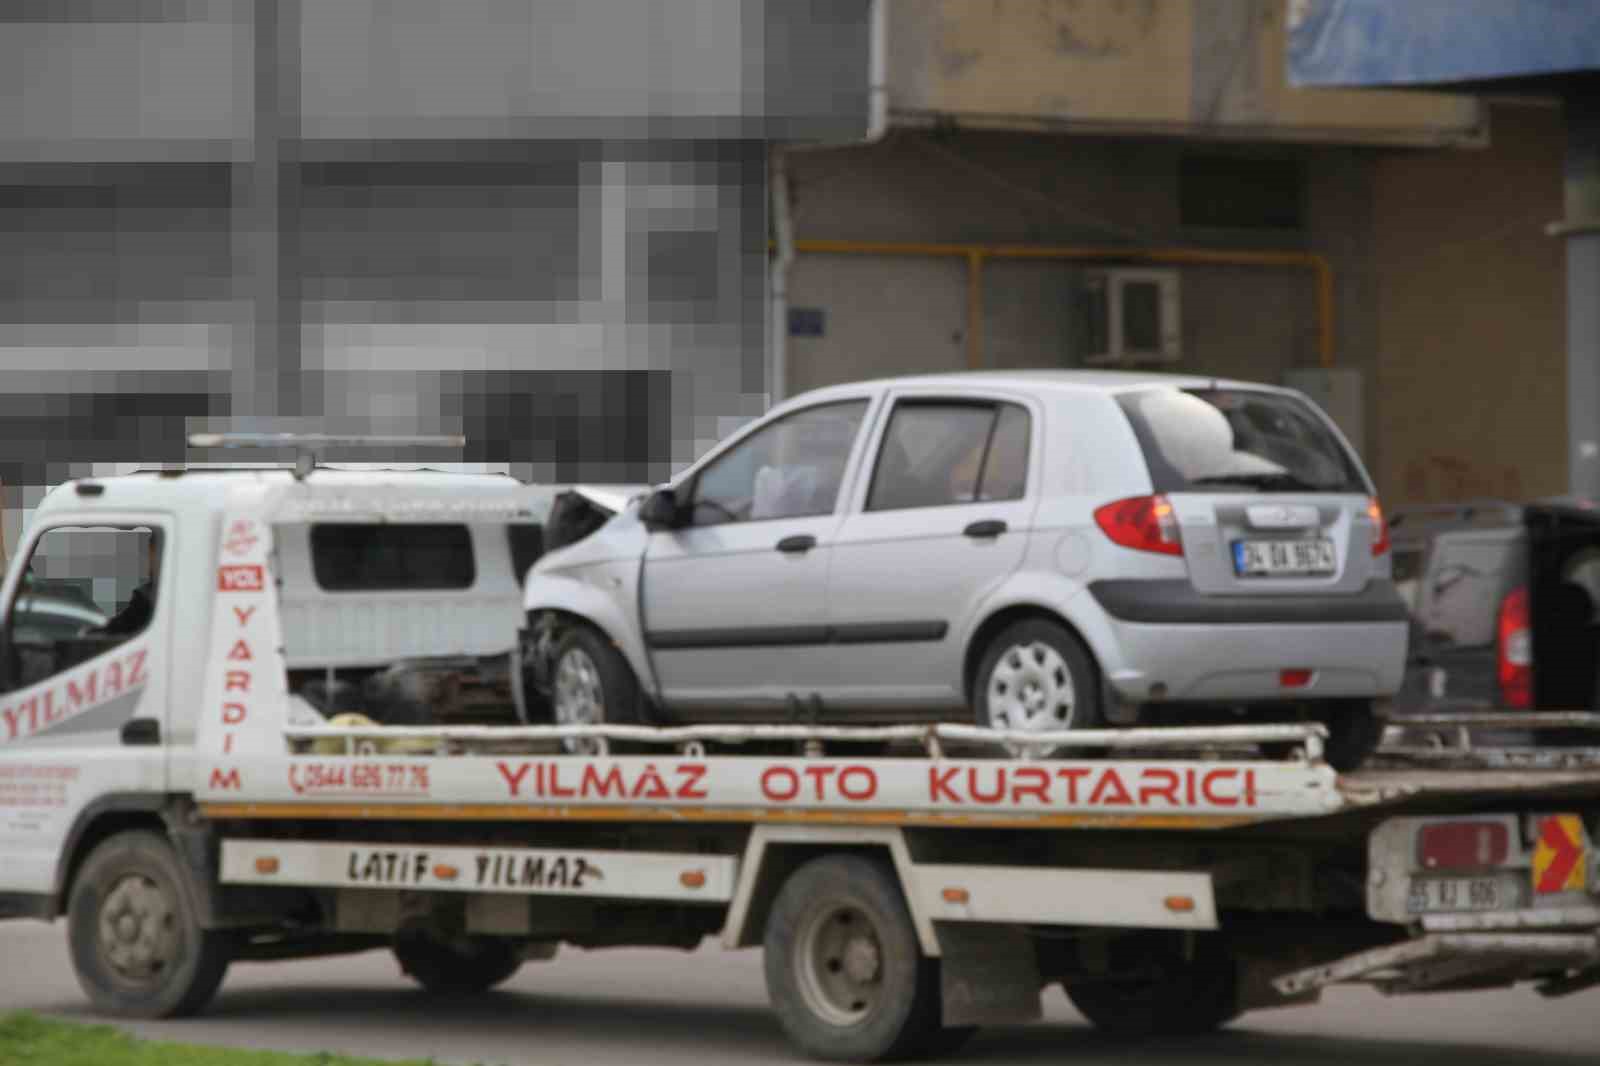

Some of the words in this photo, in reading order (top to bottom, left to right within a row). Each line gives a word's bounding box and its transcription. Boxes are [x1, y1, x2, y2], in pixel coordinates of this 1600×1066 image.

[2, 649, 148, 739] YILMAZ
[497, 763, 708, 798] YILMAZ
[761, 766, 878, 800] OTO
[929, 768, 1257, 806] KURTARICI
[475, 855, 588, 888] YILMAZ
